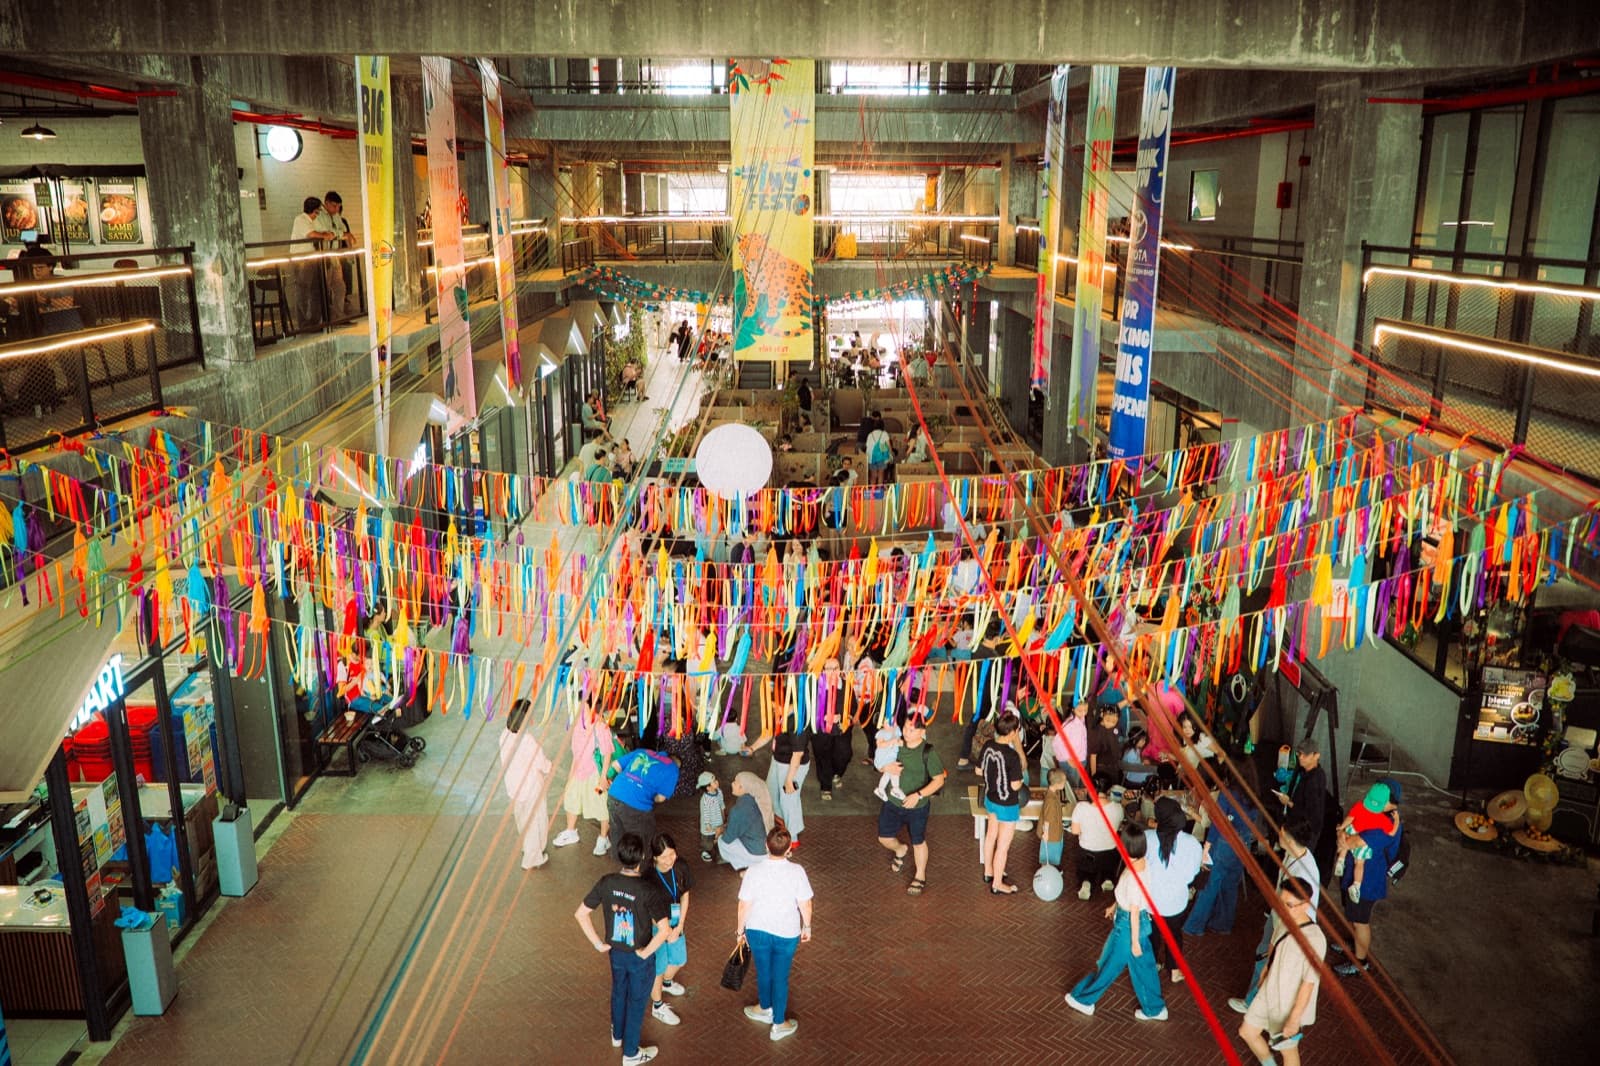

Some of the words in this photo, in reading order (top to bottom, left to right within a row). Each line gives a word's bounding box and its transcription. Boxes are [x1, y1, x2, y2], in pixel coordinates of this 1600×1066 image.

[361, 85, 384, 136] BIG
[748, 193, 795, 211] FEST
[108, 223, 133, 231] LAMB
[108, 231, 133, 240] SATAY
[1121, 325, 1150, 349] KING
